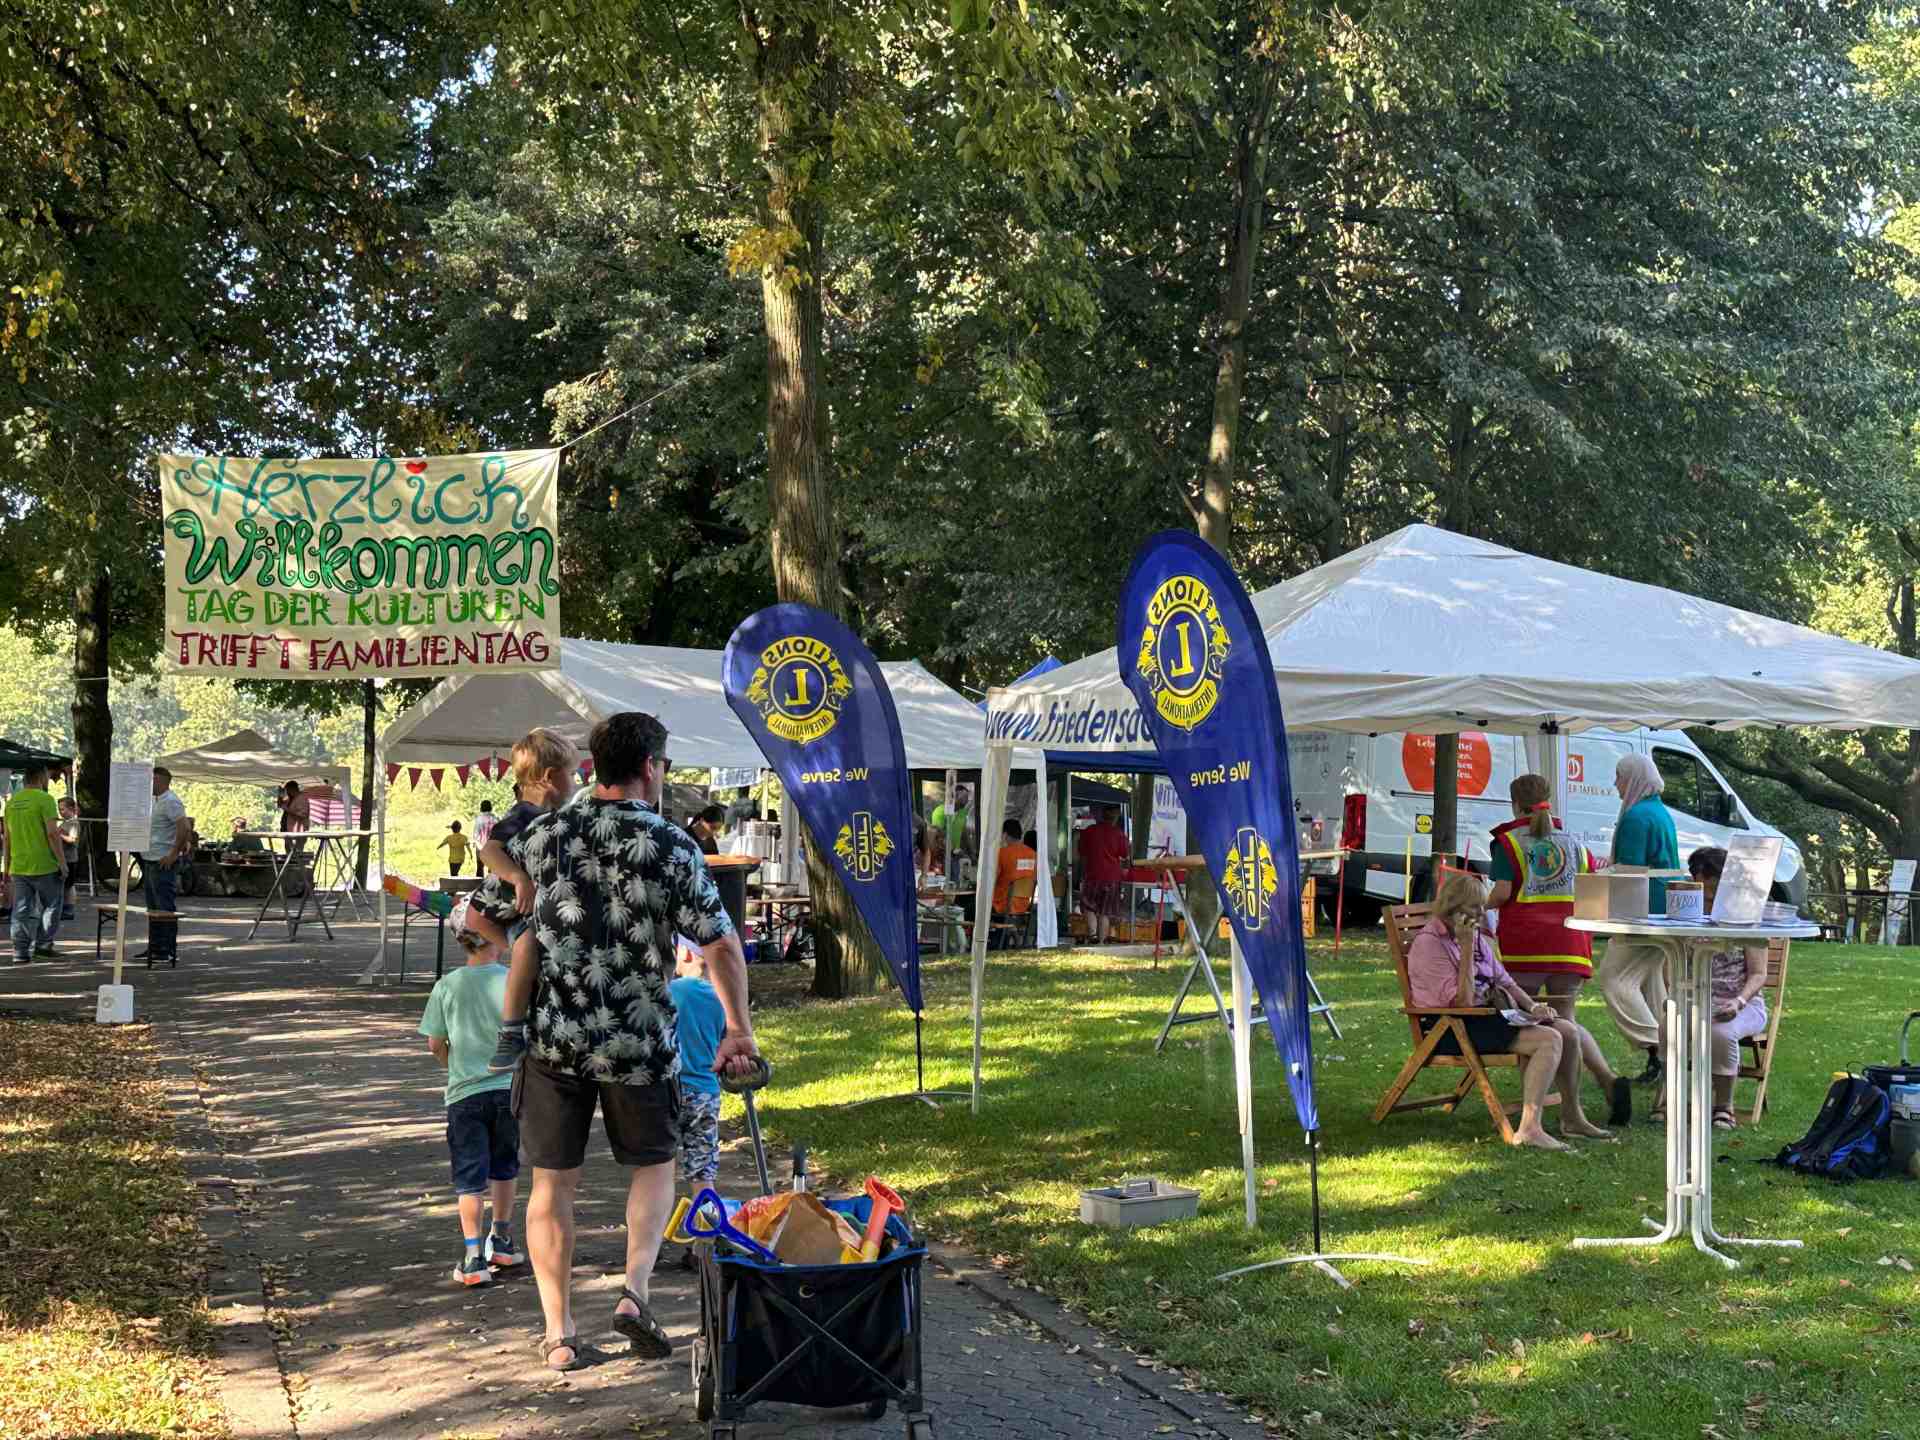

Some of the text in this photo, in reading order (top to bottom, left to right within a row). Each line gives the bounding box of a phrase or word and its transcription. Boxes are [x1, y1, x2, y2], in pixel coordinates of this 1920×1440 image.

[175, 456, 529, 528] Herzlich
[165, 509, 560, 596] Willkommen
[178, 584, 546, 626] TAG DER KULTUREN
[171, 630, 550, 671] TRIFFT FAMILIENTAG
